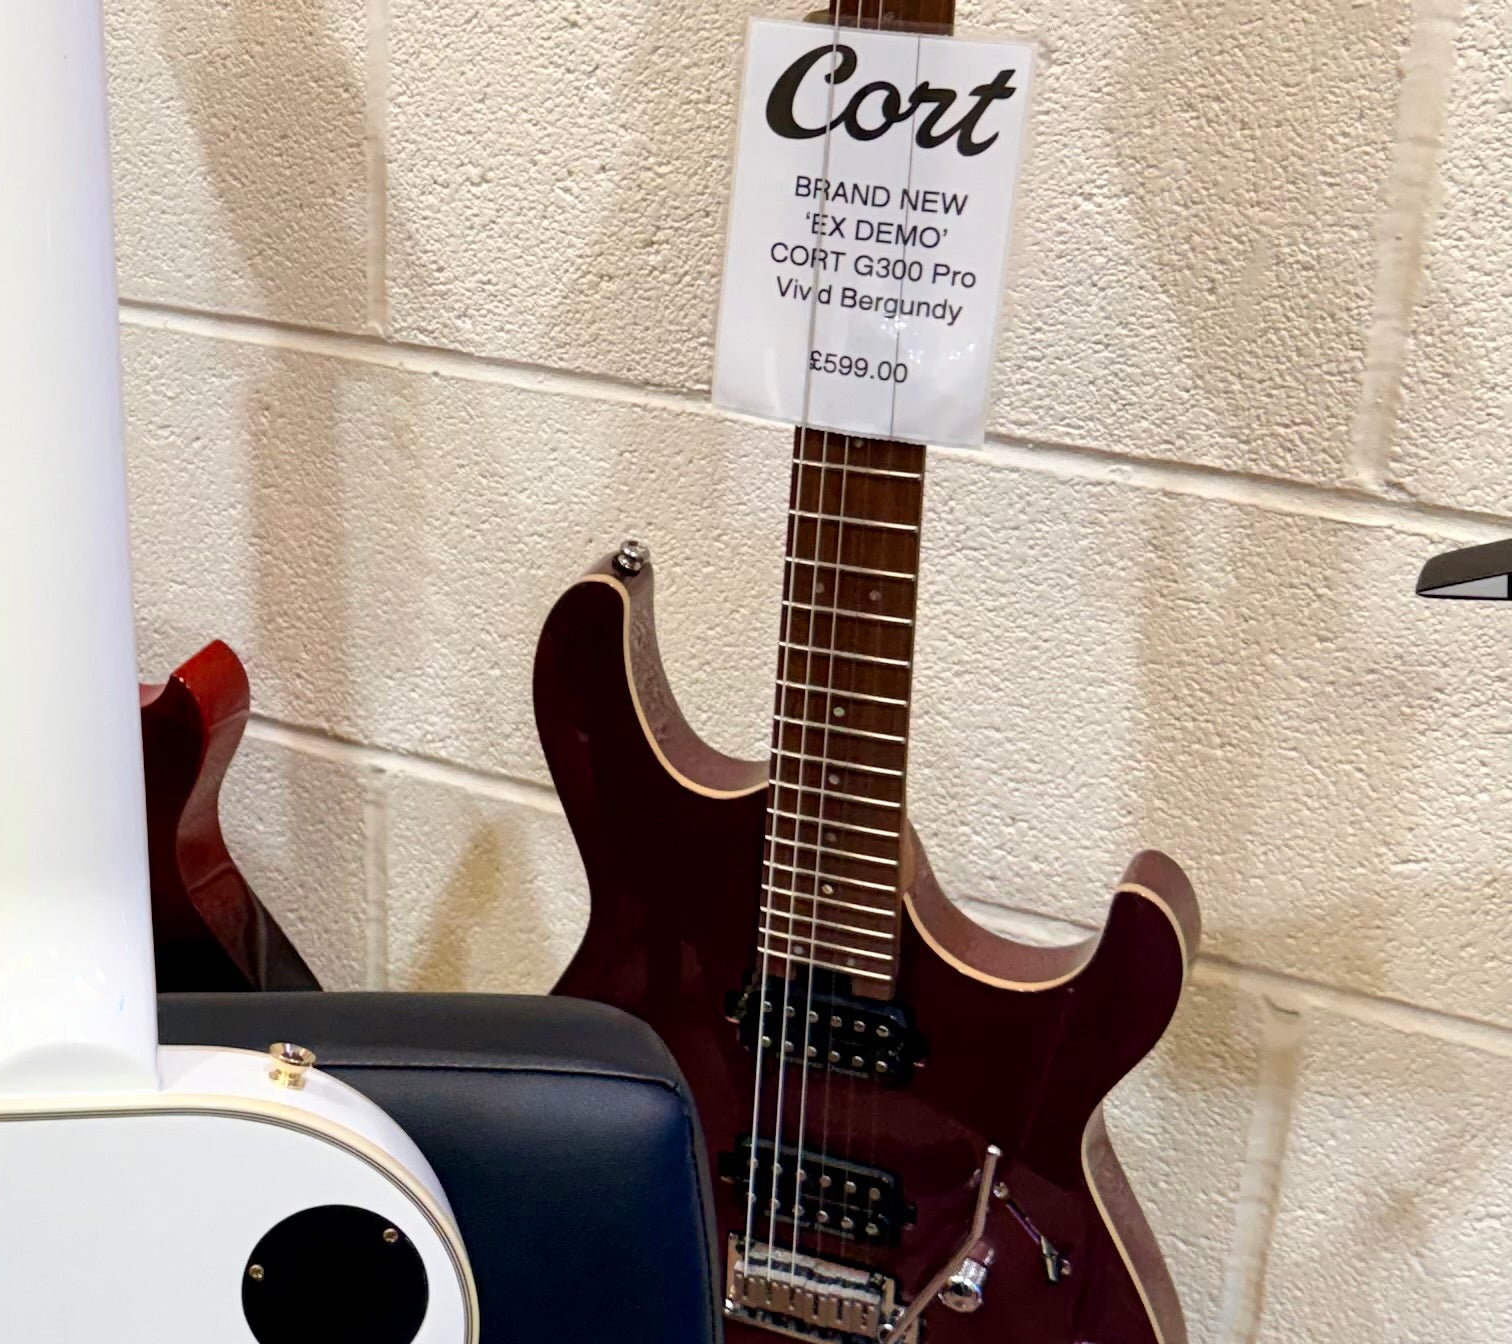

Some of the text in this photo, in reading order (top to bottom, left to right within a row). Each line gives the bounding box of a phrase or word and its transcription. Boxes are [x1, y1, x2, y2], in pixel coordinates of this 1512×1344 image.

[765, 44, 1017, 157] Cort
[794, 176, 969, 216] BRAND NEW
[770, 242, 977, 289] CORT G300 Pro
[776, 275, 964, 327] Vivd Bergundy
[809, 350, 908, 384] £599.00
